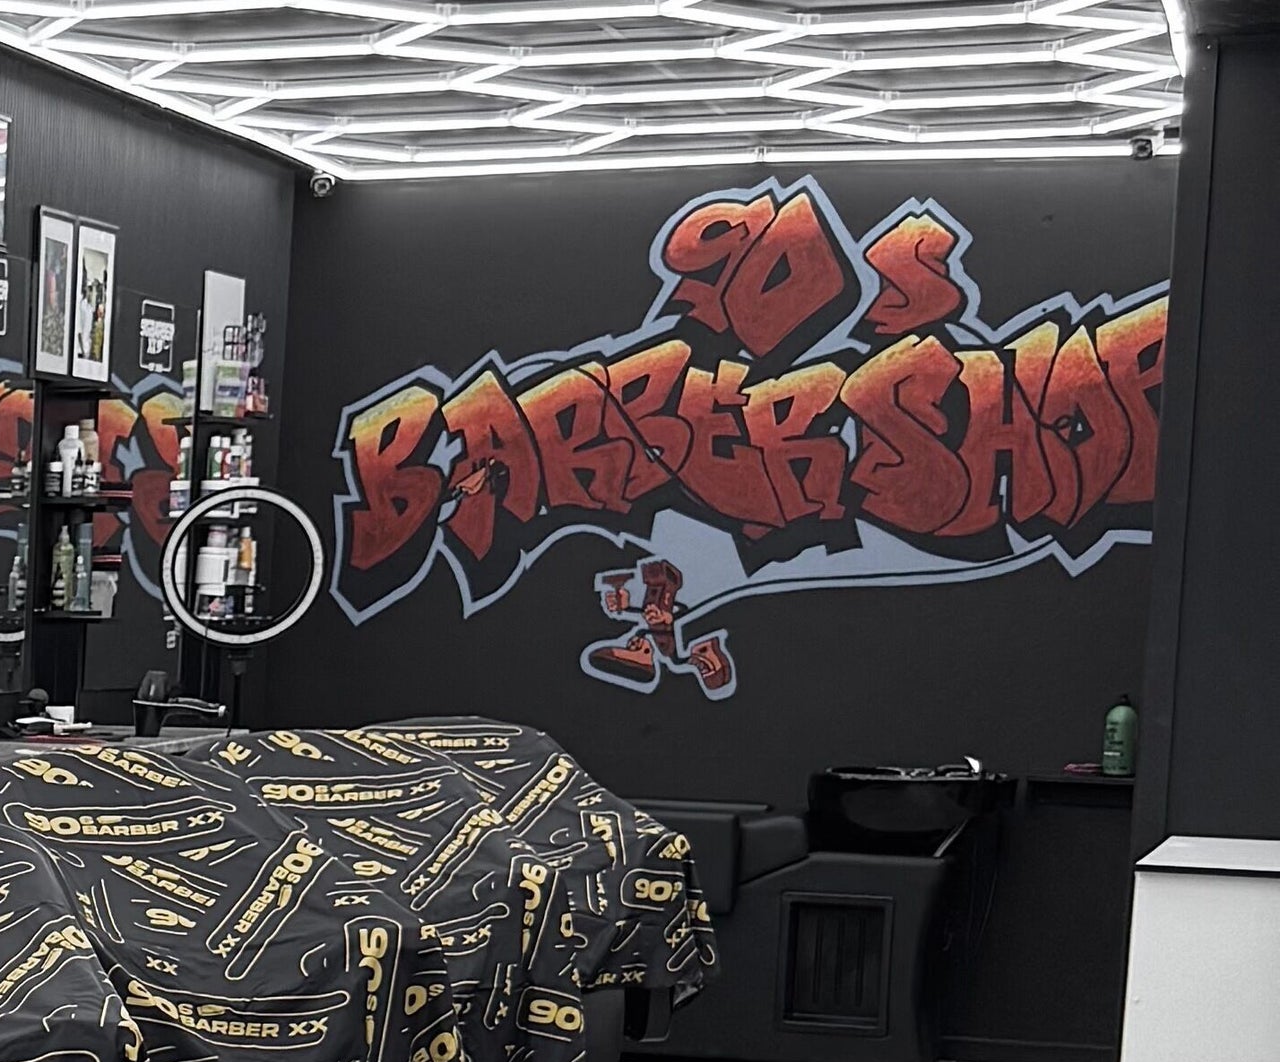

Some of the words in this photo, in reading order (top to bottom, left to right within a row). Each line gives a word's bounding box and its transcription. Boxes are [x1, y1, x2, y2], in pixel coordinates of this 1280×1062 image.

[81, 819, 180, 837] BARBER
[186, 810, 226, 829] XX
[233, 865, 287, 932] BARBER
[146, 955, 179, 976] XX
[178, 1014, 280, 1038] BARBER
[287, 1016, 329, 1038] XX
